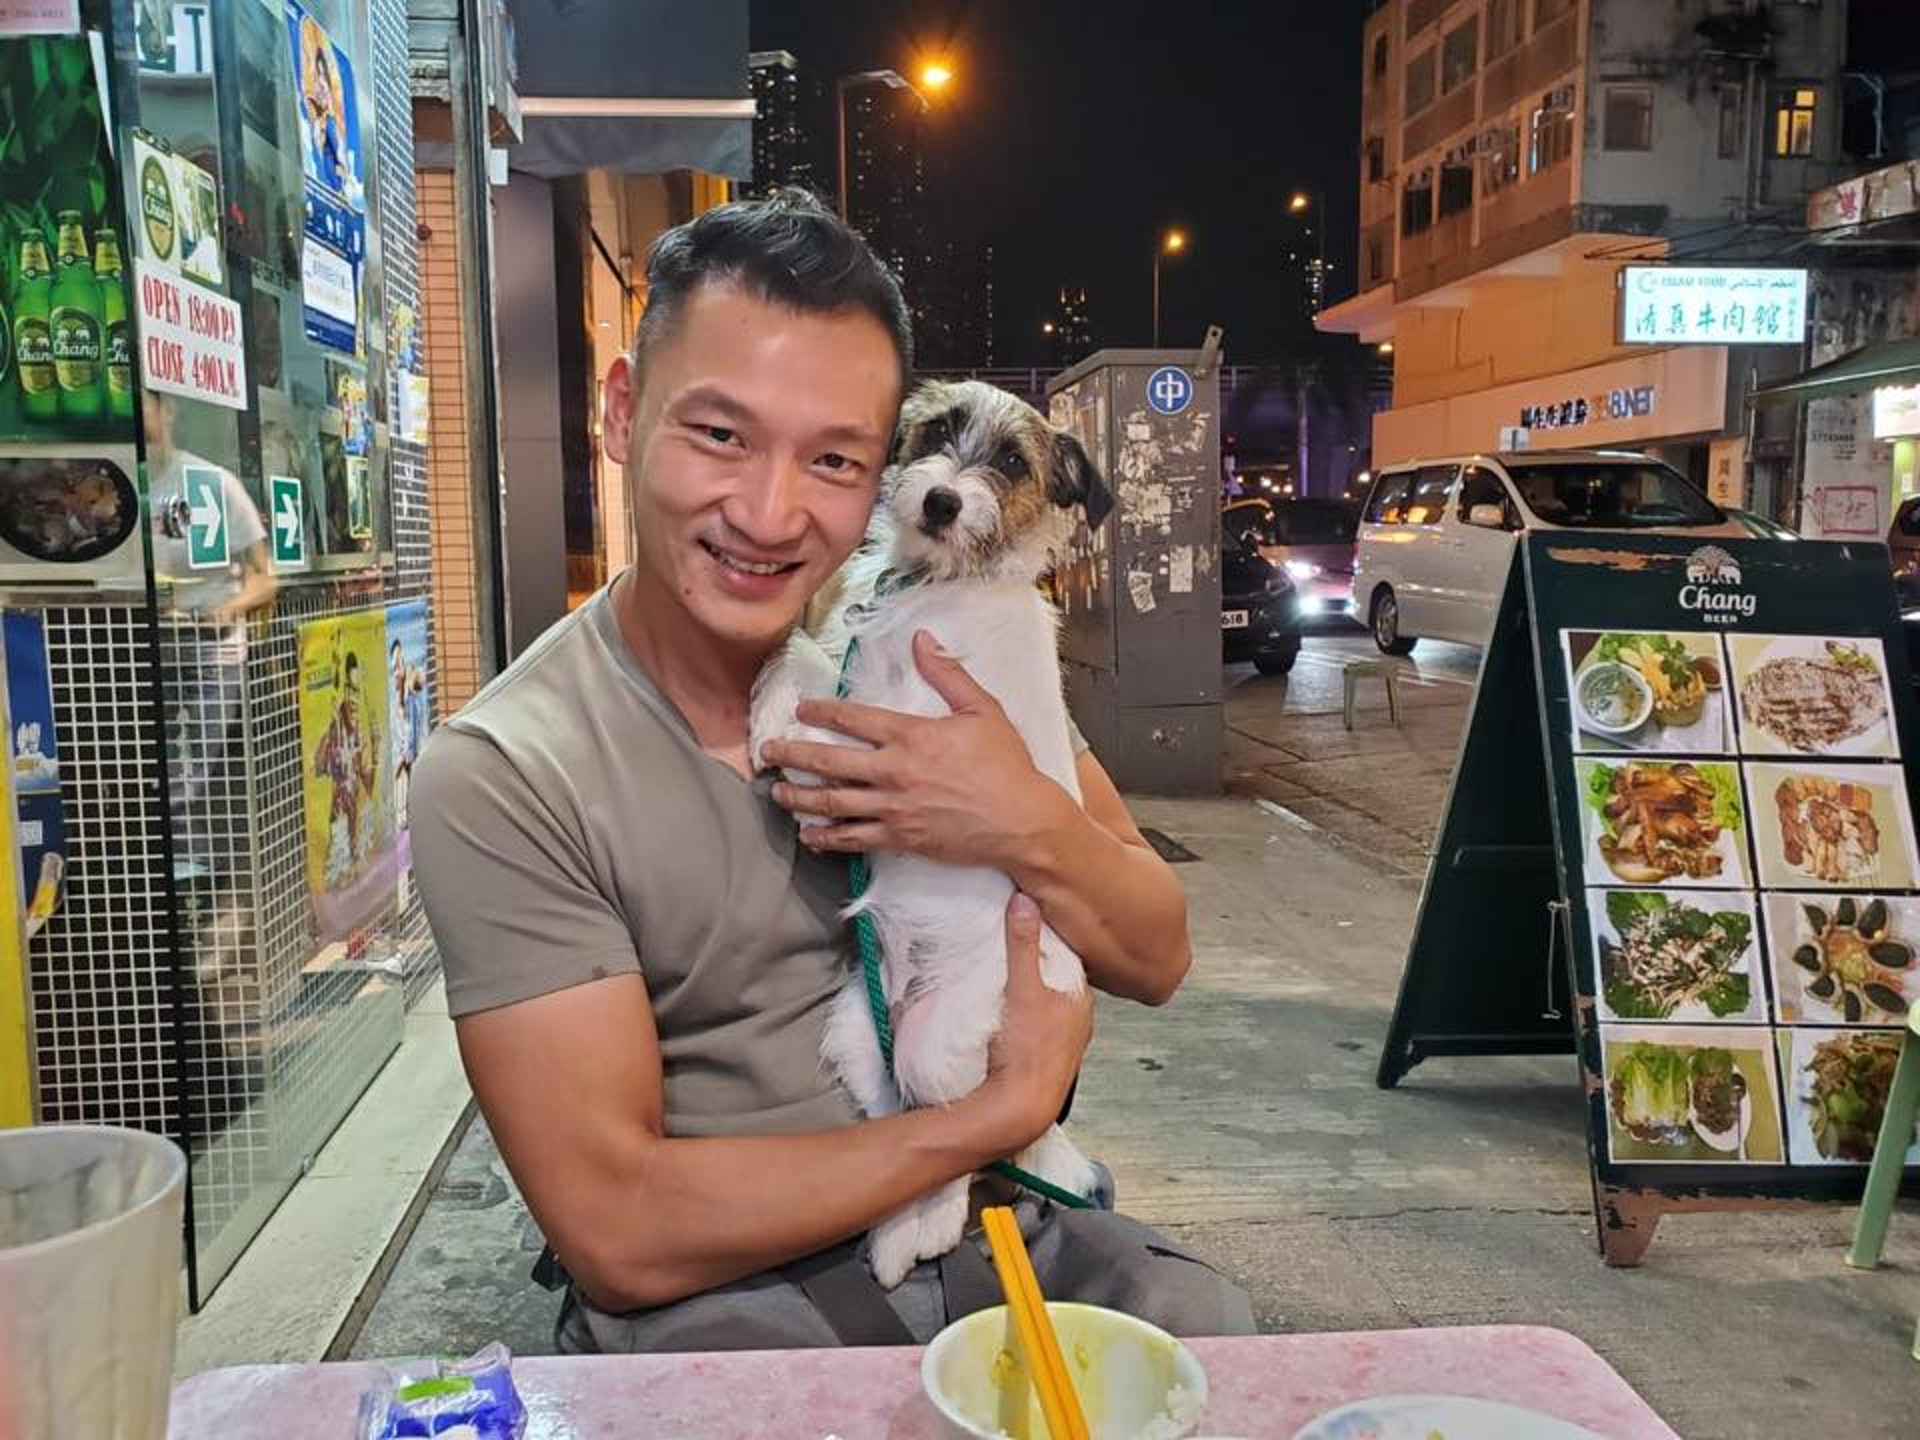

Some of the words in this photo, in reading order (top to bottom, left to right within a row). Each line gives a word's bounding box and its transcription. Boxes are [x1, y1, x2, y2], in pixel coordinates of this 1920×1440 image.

[143, 274, 181, 327] OPEN
[147, 335, 185, 385] CLOSE
[1679, 585, 1756, 616] Chang
